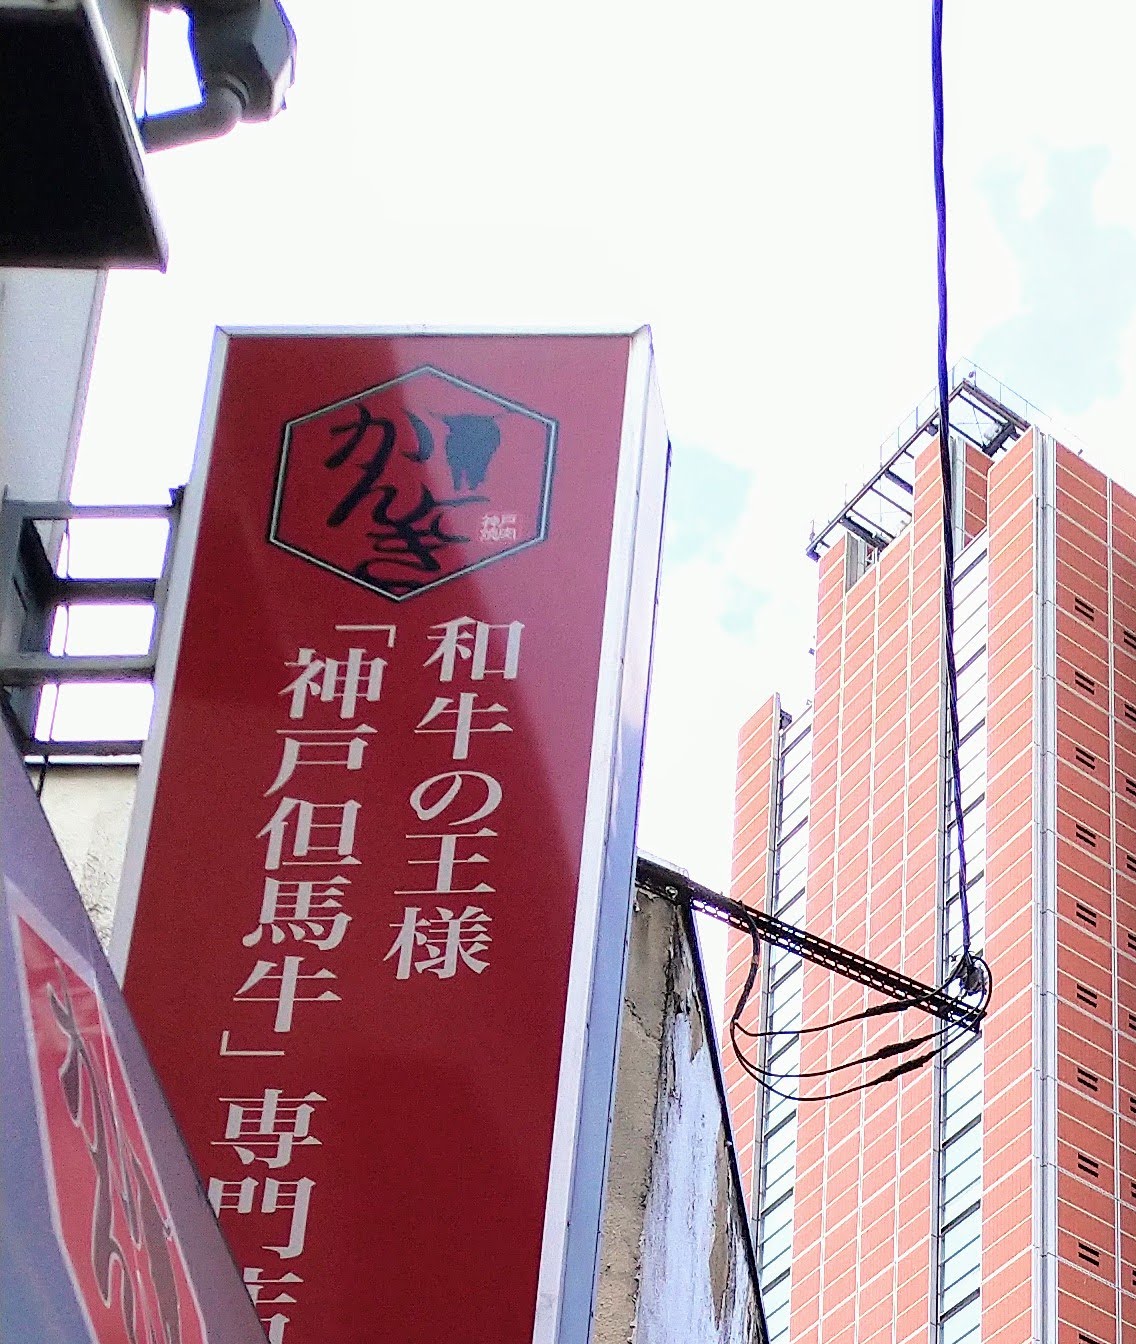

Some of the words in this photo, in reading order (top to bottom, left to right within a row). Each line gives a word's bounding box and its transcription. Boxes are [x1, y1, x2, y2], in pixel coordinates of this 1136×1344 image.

[384, 614, 525, 981] 和牛の王様
